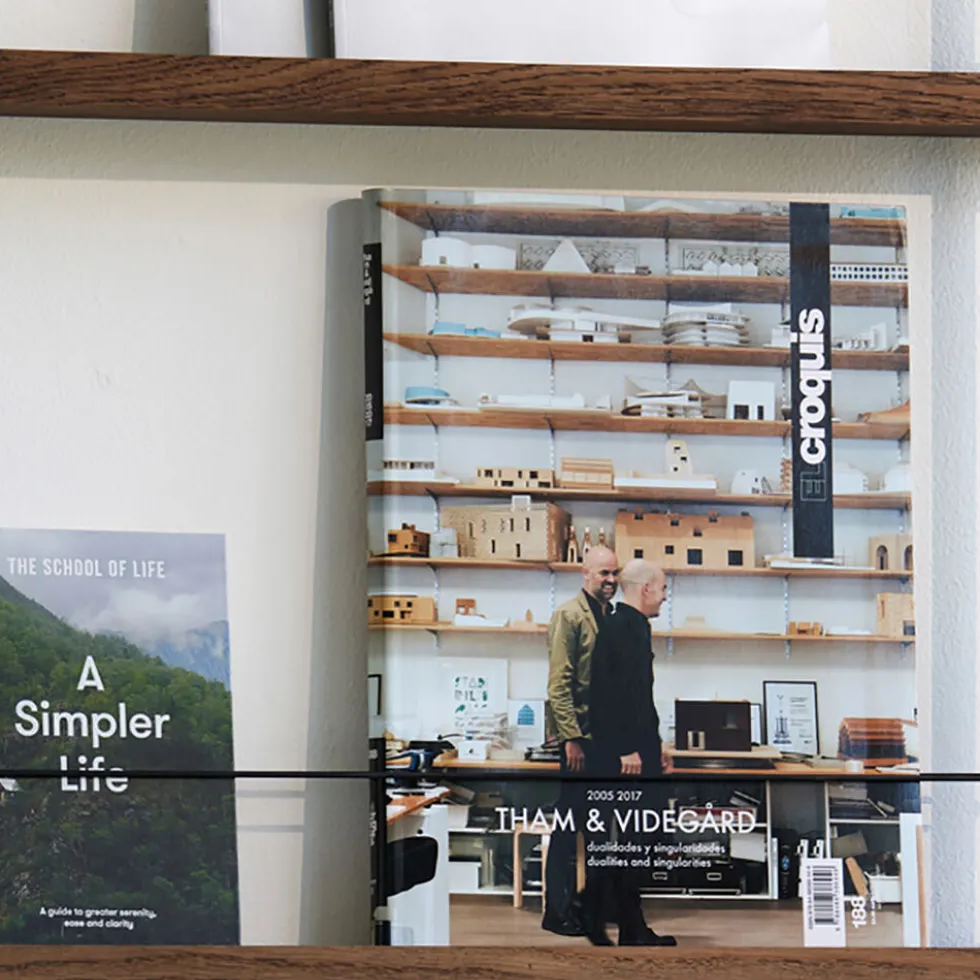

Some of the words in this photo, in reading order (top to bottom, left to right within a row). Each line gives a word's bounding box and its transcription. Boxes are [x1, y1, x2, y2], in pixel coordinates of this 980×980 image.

[790, 308, 832, 465] croquis
[6, 556, 37, 576] THE
[43, 557, 103, 577] SCHOOL
[108, 559, 127, 577] OF
[132, 560, 166, 579] LIFE
[77, 655, 105, 692] A
[14, 700, 171, 749] Simpler
[60, 755, 129, 793] Life
[586, 790, 614, 801] 2005
[617, 790, 642, 802] 2017
[495, 807, 576, 832] THAM
[586, 808, 606, 833] &
[614, 802, 757, 834] VIDEGÅRD
[586, 841, 642, 853] dualidades
[644, 844, 651, 855] y
[653, 842, 726, 856] singularidades
[586, 855, 629, 867] dualities
[631, 856, 651, 868] and
[653, 857, 712, 870] singularities
[40, 906, 47, 915] A
[48, 906, 72, 918] guide
[74, 907, 84, 916] to
[85, 907, 118, 918] greater
[119, 907, 157, 920] serenity,
[64, 920, 85, 928] ease
[86, 919, 104, 928] and
[105, 919, 134, 930] clarity
[851, 896, 867, 929] 188
